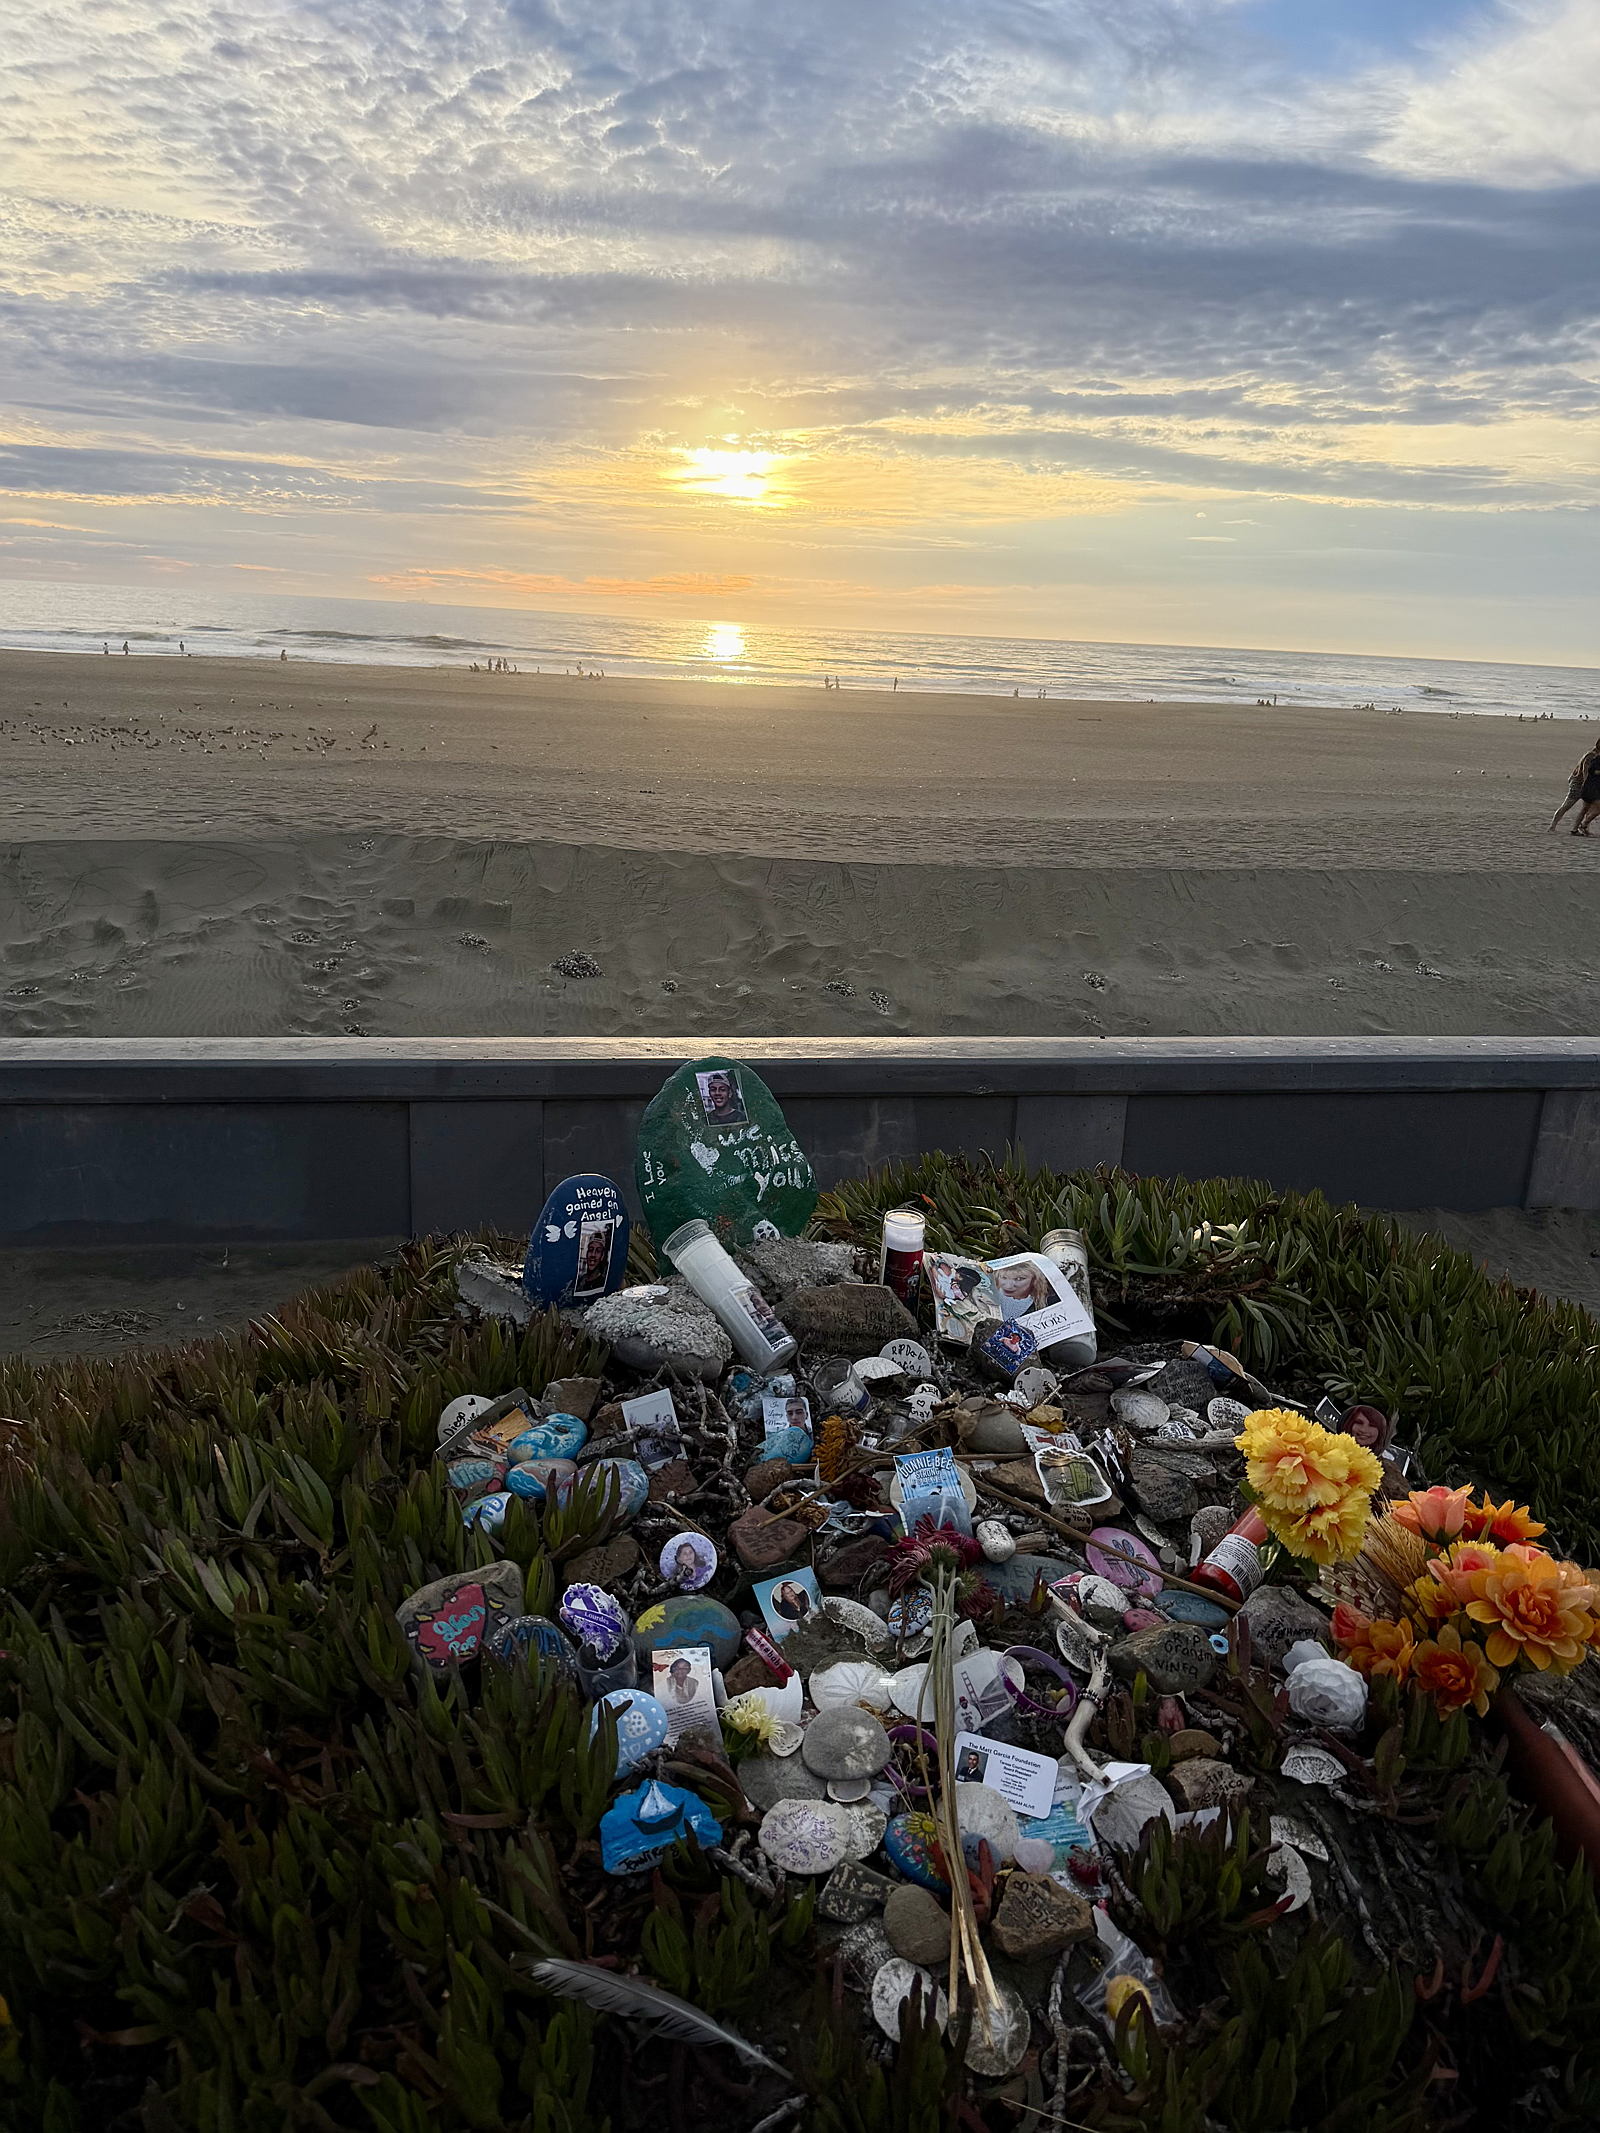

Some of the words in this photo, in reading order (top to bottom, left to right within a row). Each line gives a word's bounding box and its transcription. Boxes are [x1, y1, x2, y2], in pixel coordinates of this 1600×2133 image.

[575, 1186, 617, 1199] Heaven
[565, 1198, 603, 1217] gained
[607, 1200, 619, 1210] an
[581, 1208, 612, 1222] Angel
[443, 1411, 466, 1437] Diego
[900, 1455, 933, 1479] DONNIE
[934, 1455, 954, 1472] BEE
[584, 1611, 609, 1625] Lourdes
[1173, 1630, 1202, 1646] RIP
[968, 1742, 979, 1750] The
[979, 1744, 992, 1754] Matt
[992, 1749, 1011, 1760] Garcia
[1011, 1754, 1041, 1769] Foundation
